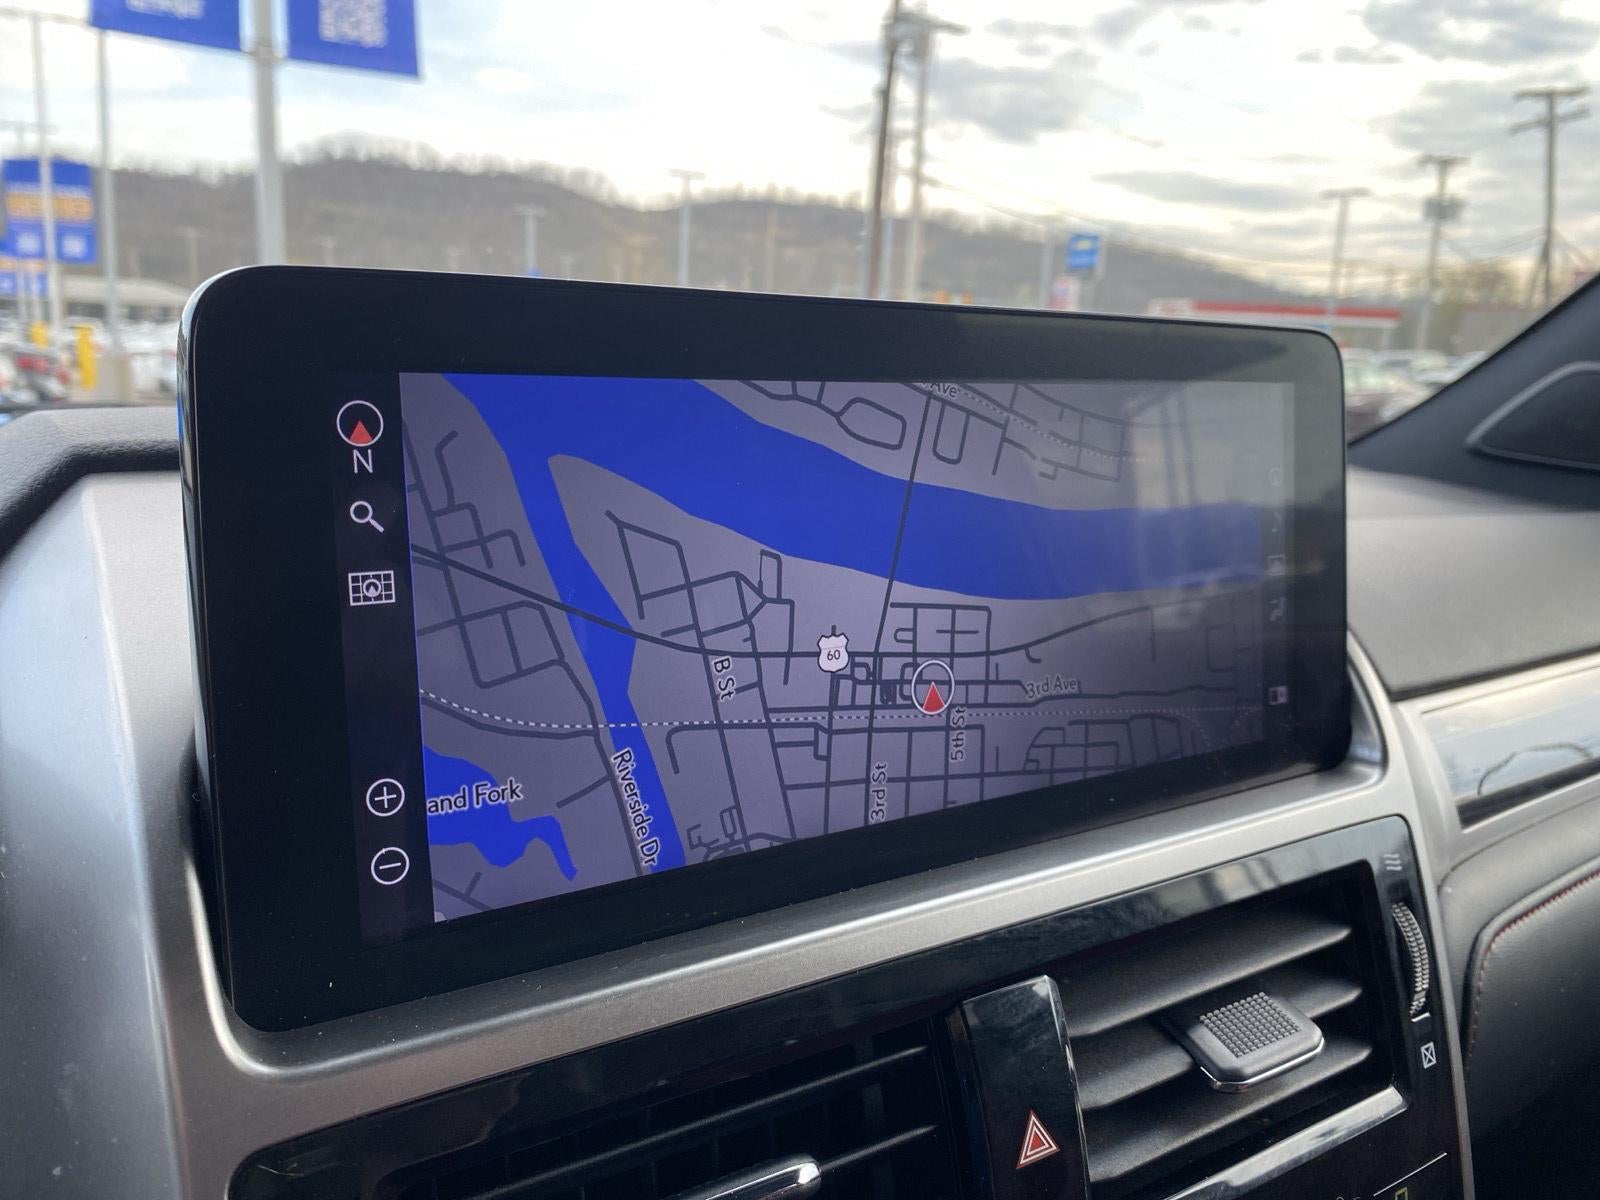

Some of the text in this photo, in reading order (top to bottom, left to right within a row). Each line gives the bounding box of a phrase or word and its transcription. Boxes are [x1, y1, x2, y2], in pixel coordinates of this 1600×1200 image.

[929, 382, 957, 398] Ave
[353, 449, 373, 473] N
[827, 649, 841, 661] 60
[713, 657, 735, 701] B St
[1026, 674, 1077, 699] 3rd Ave
[950, 707, 967, 761] 5th St
[474, 778, 522, 806] Fork
[870, 762, 887, 821] 3rd St
[612, 748, 660, 865] Riverside Dr
